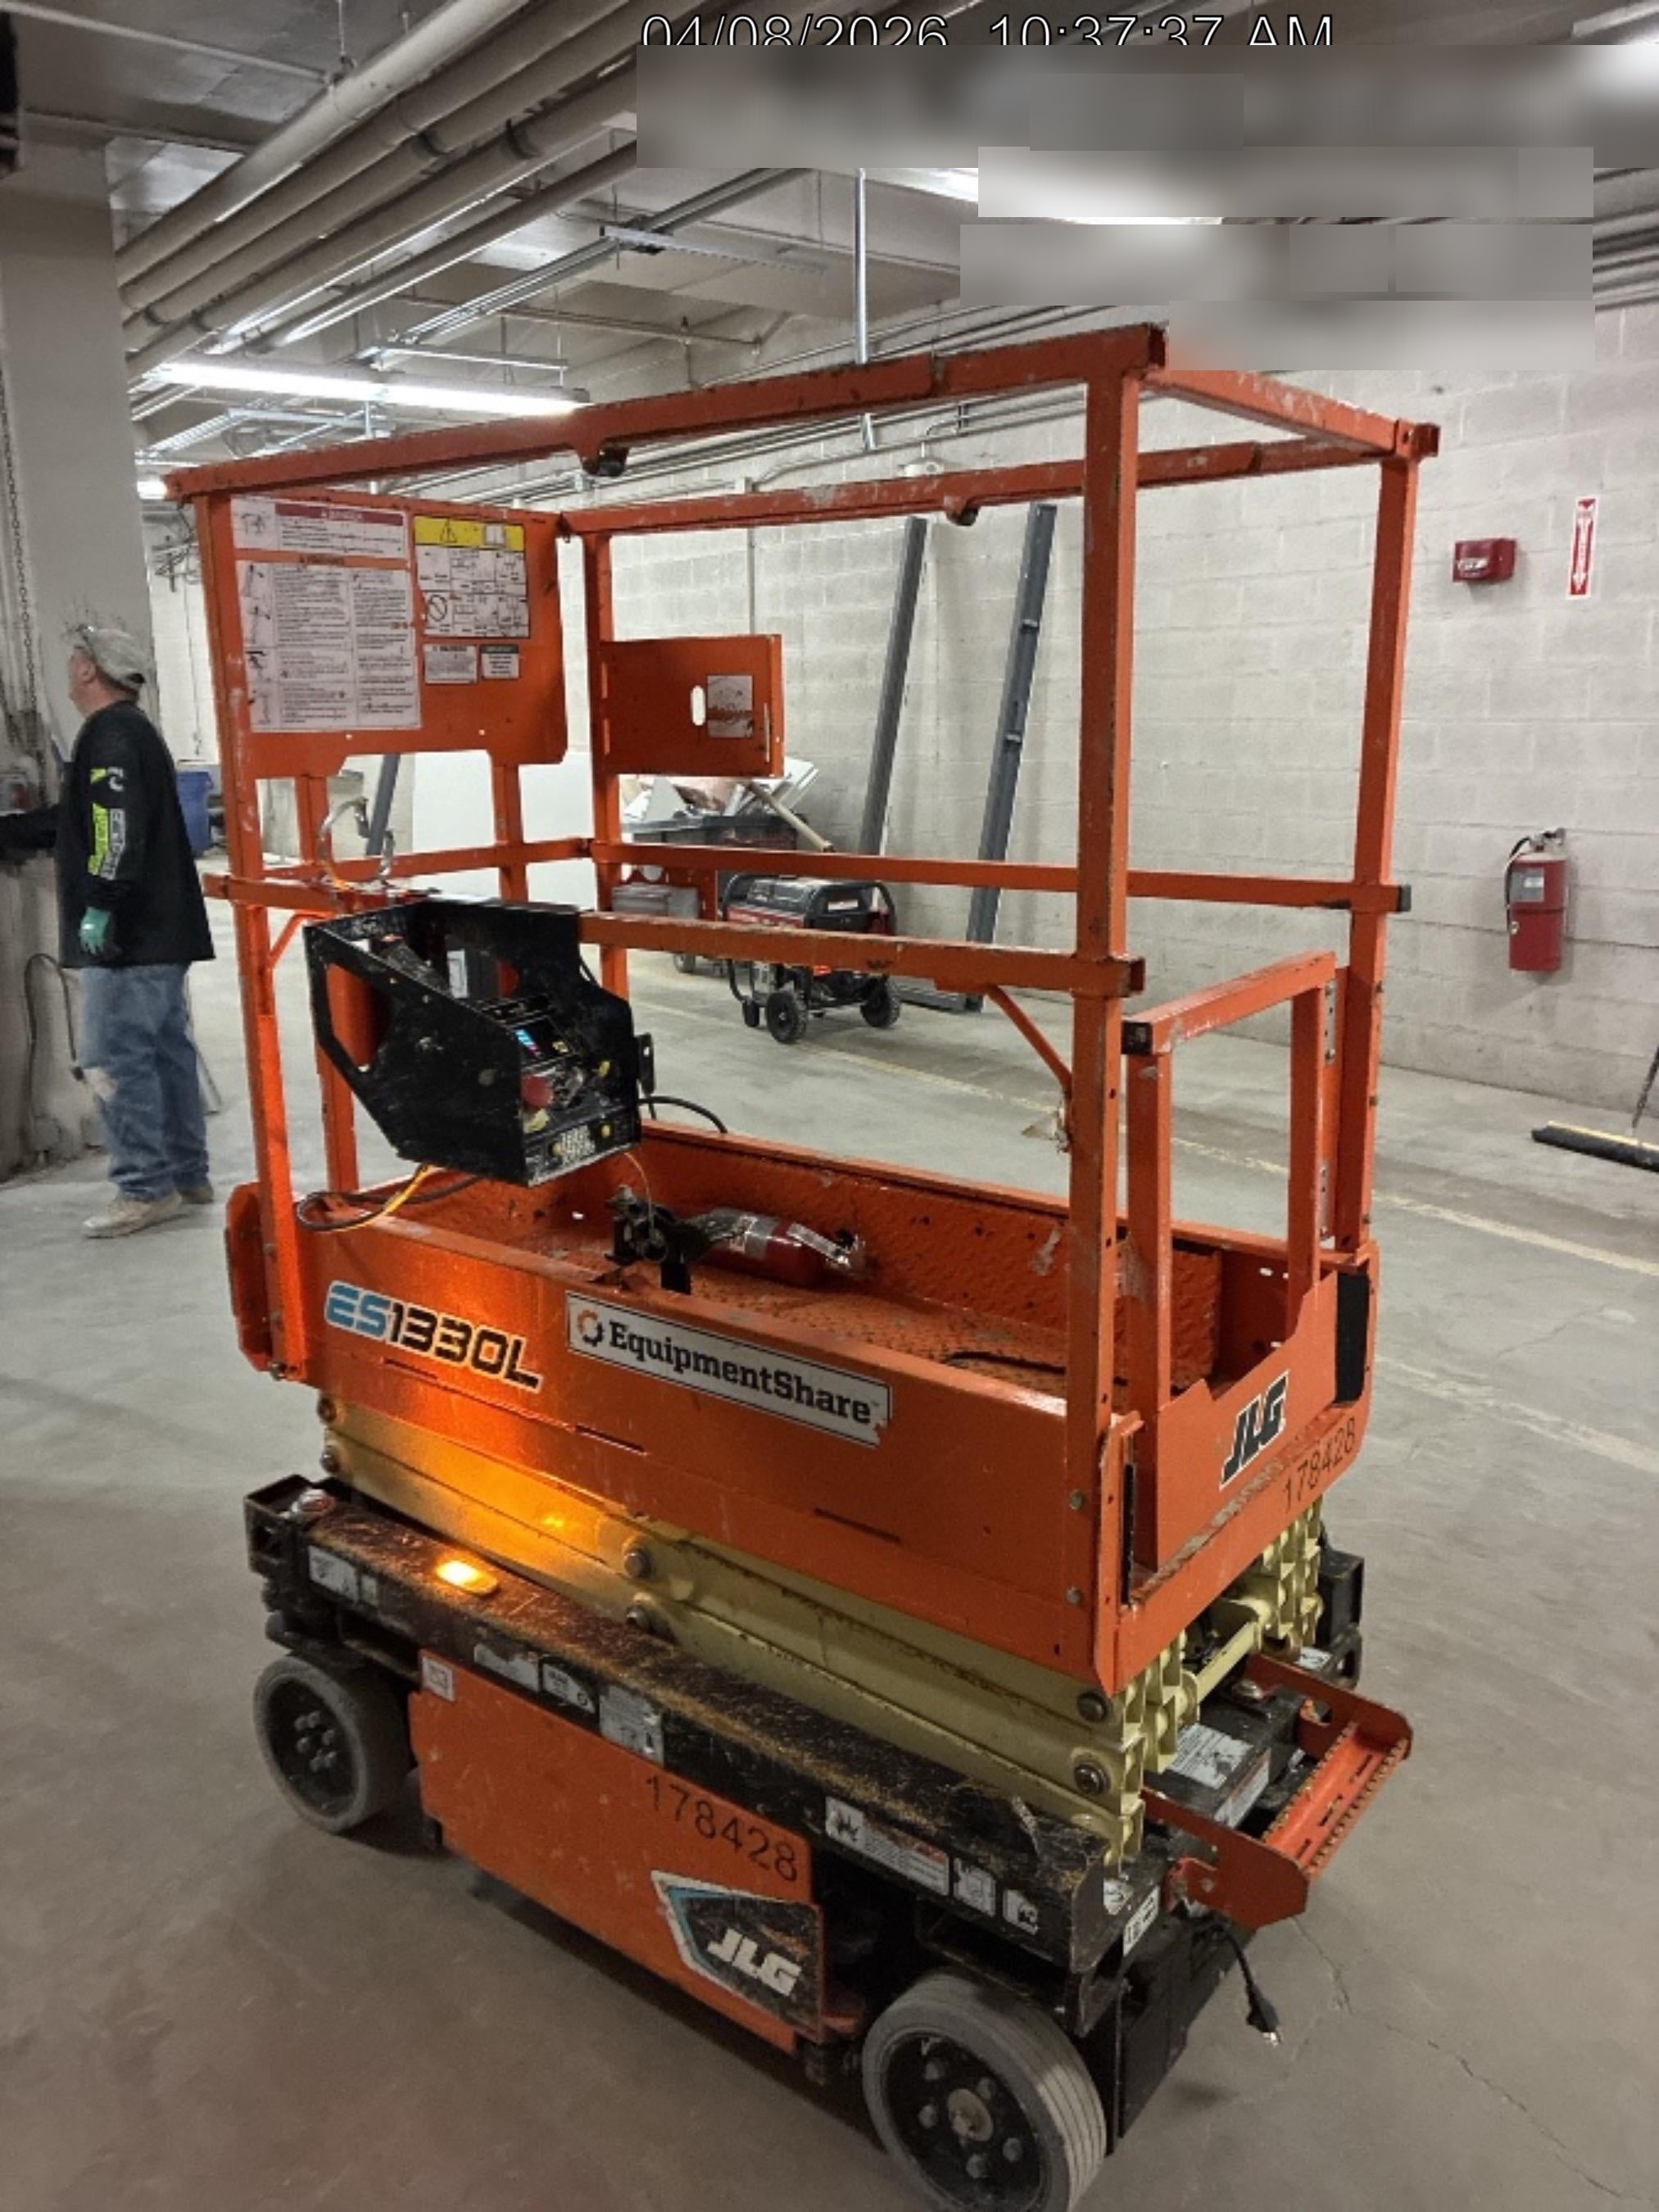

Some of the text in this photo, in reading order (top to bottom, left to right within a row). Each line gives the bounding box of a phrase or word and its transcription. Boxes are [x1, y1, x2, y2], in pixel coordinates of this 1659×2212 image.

[325, 1283, 540, 1389] ES1330L
[609, 1320, 872, 1425] EquipmentShare
[1220, 1370, 1289, 1489] JLG
[1283, 1417, 1356, 1514] 178428
[646, 1775, 798, 1882] 178428
[706, 1927, 803, 1998] JLG
